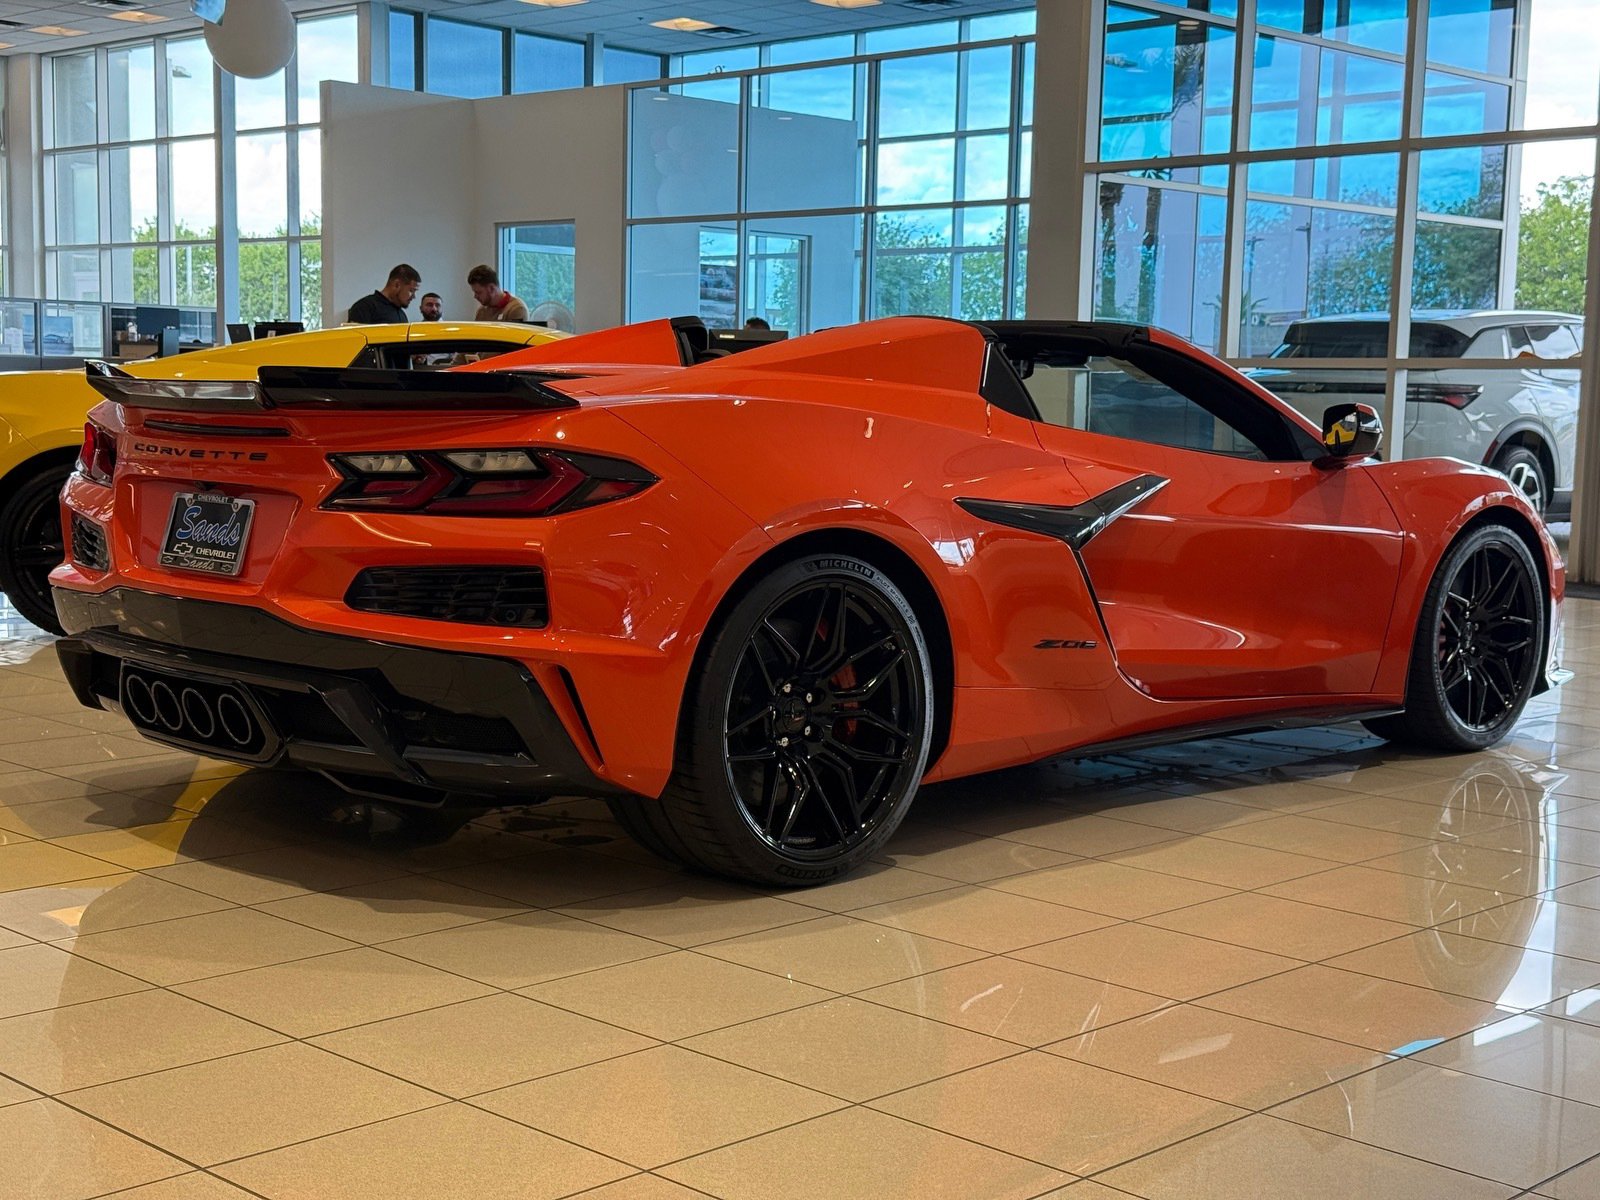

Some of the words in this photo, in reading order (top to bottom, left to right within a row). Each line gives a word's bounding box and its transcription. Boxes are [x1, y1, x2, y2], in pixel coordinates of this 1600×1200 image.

[134, 443, 268, 461] CORVETTE
[197, 494, 229, 503] CHEVROLET
[176, 506, 241, 546] Sands
[195, 548, 237, 560] CHEVROLET
[180, 555, 216, 571] Sands
[819, 560, 872, 577] MICHELIN
[1033, 639, 1097, 649] Z06
